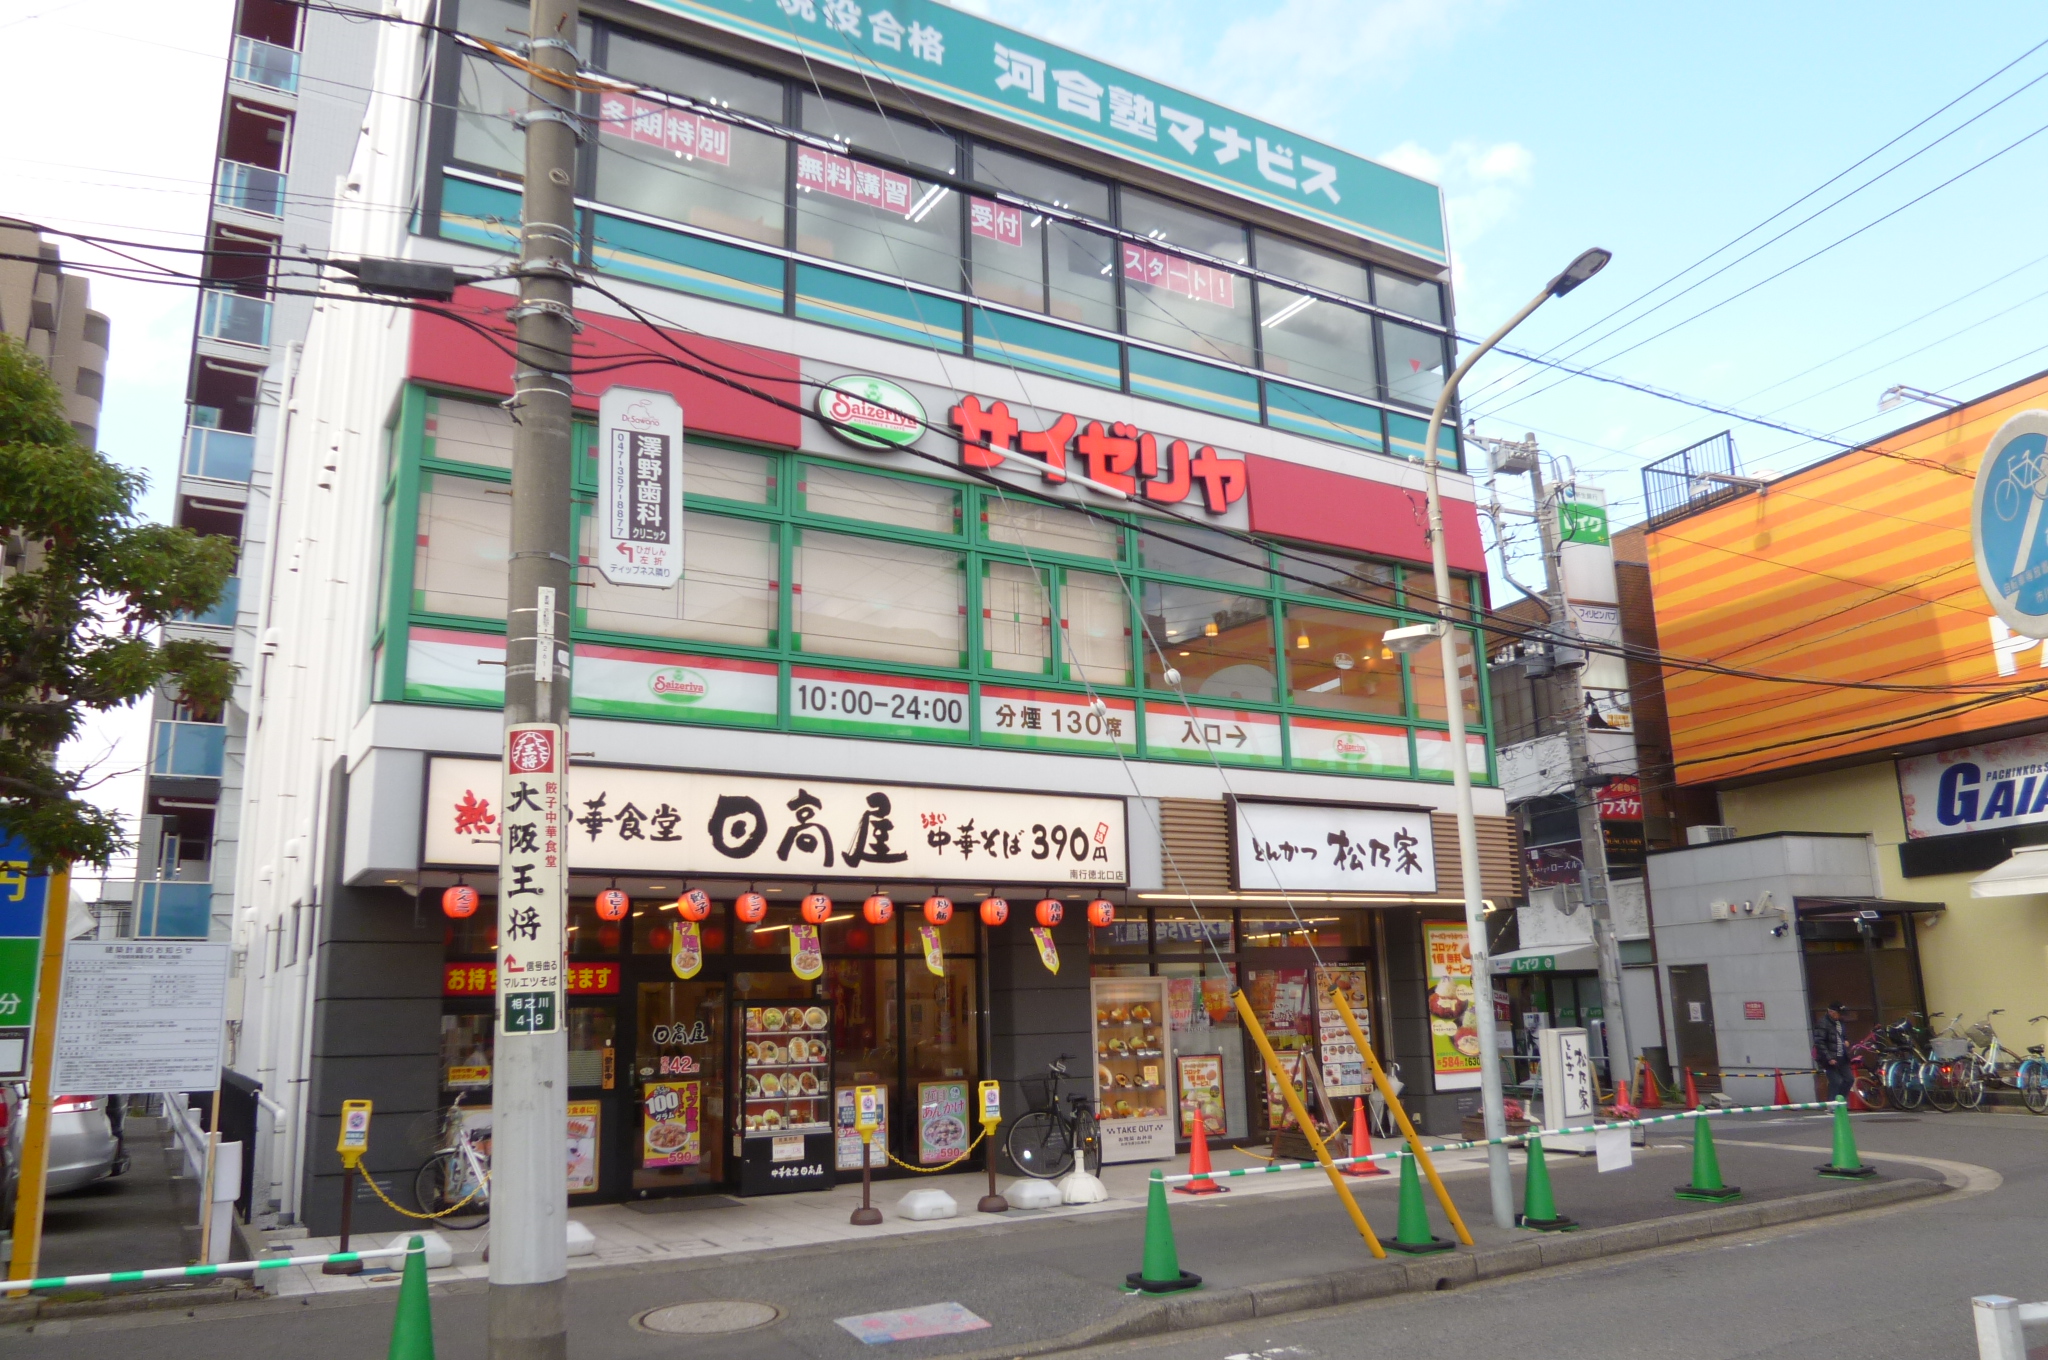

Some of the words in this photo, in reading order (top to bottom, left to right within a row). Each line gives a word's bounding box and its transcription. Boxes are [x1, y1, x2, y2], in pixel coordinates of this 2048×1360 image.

[994, 42, 1341, 204] 河合塾マナビス
[601, 98, 728, 157] 冬期特別
[798, 154, 910, 209] 無料講習
[971, 203, 1019, 239] 受付
[949, 395, 1246, 514] サイゼリヤ
[637, 434, 662, 526] 澤野歯科
[632, 528, 667, 541] クリニック
[654, 676, 704, 695] Saizeriya
[1182, 719, 1220, 745] 入口
[545, 782, 557, 868] 餃子中華食堂
[708, 788, 907, 869] 日高屋
[506, 781, 544, 941] 大阪王将
[1252, 836, 1317, 864] とんかつ
[1327, 827, 1423, 875] 松乃家
[1070, 869, 1124, 881] 南行徳北口店
[606, 892, 624, 916] 生ビール
[936, 899, 949, 920] 炒飯
[1431, 943, 1458, 951] コロッケ
[526, 960, 557, 972] 信号曲る
[1516, 957, 1539, 971] レイク
[504, 975, 557, 988] マルエツそば
[511, 997, 549, 1009] 相之川
[516, 1013, 544, 1026] 4-8
[653, 1021, 708, 1044] 日高屋
[1575, 1048, 1589, 1110] 松乃家
[645, 1092, 679, 1115] 100
[1116, 1126, 1136, 1134] TAKE
[1138, 1125, 1153, 1133] OUT
